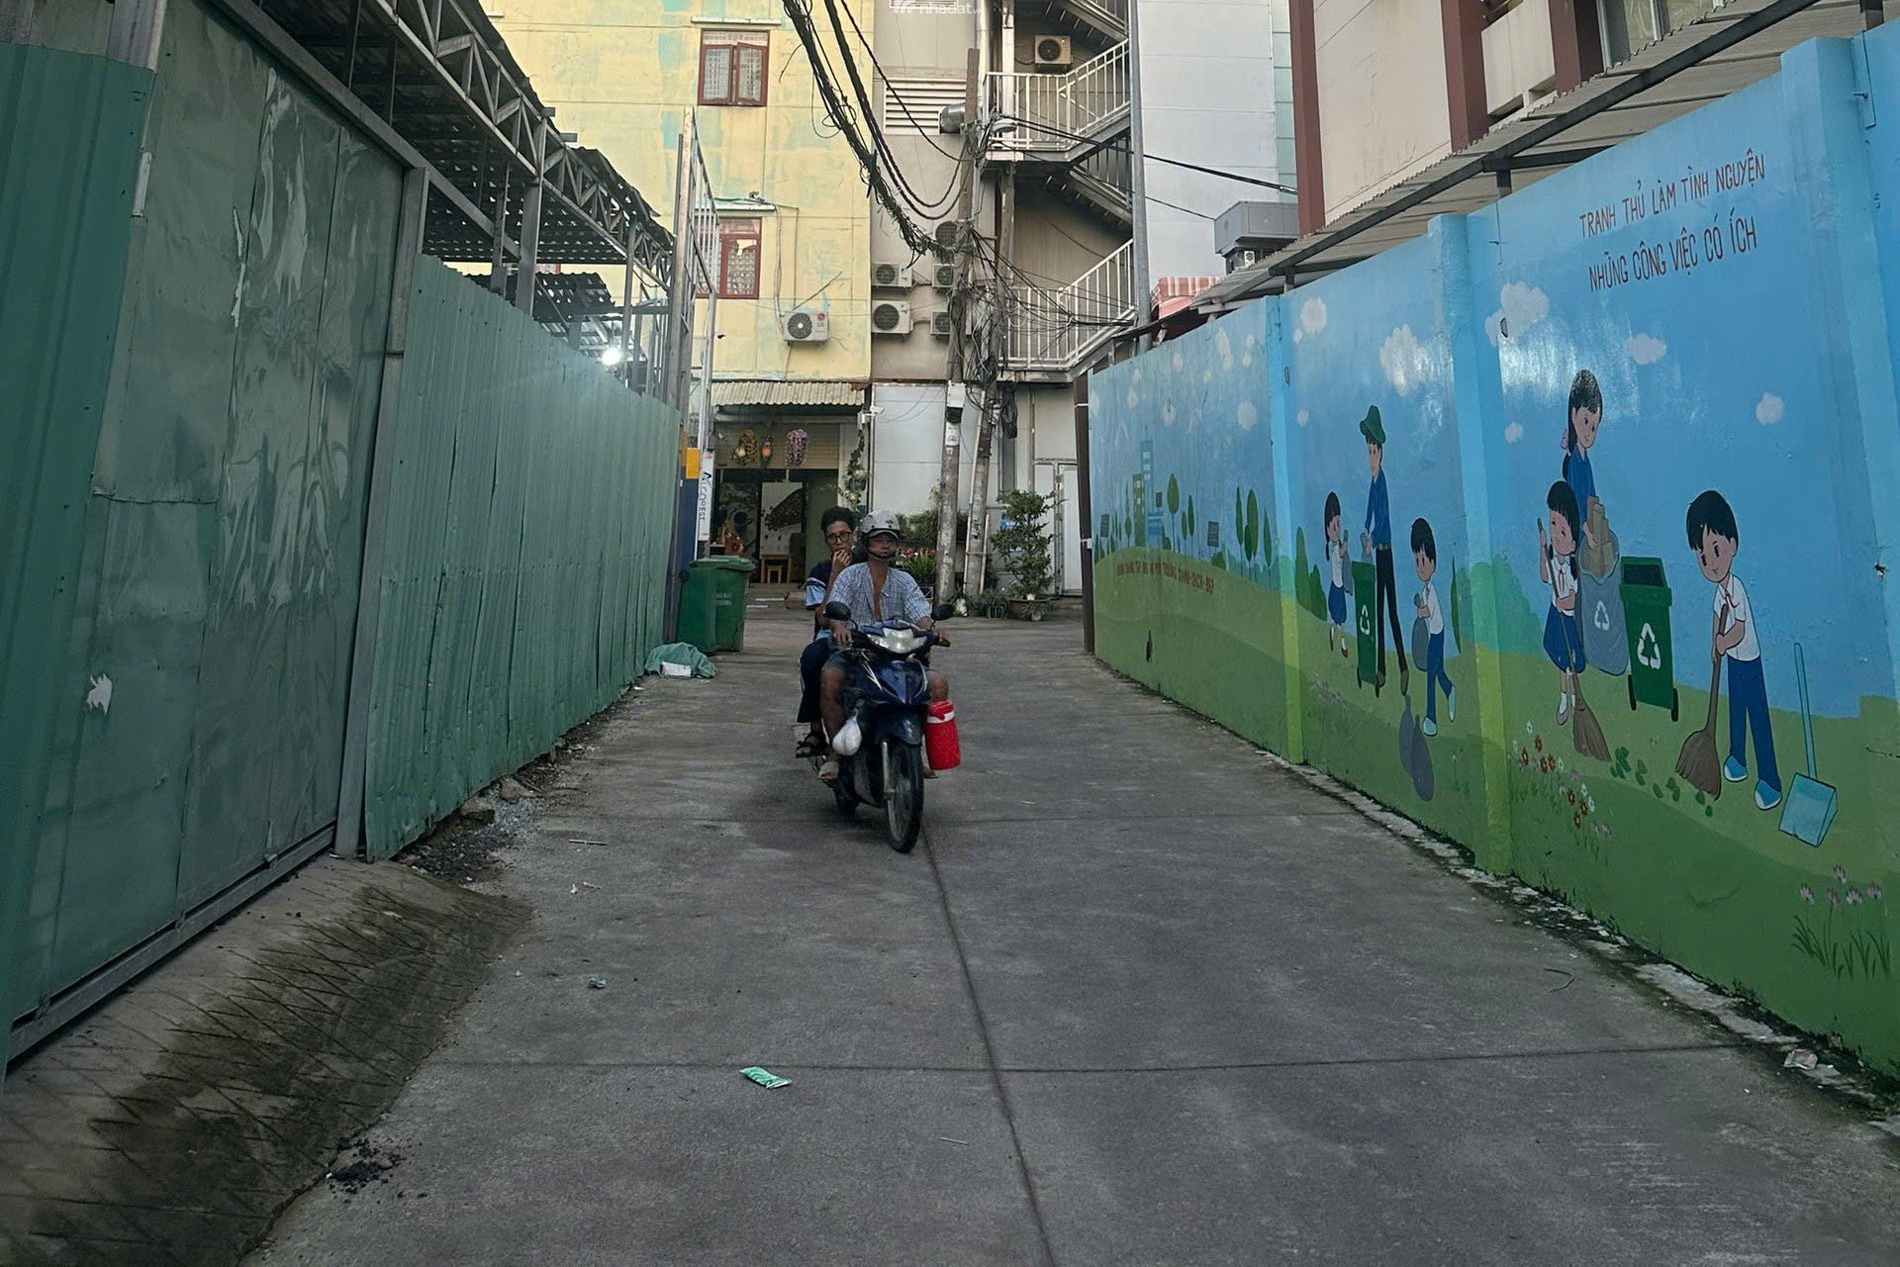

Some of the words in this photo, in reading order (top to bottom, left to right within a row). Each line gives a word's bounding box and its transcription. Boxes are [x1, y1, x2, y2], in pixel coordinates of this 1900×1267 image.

[1580, 204, 1616, 238] TRANH
[1622, 180, 1645, 223] THỦ
[1652, 179, 1676, 215] LÀM
[1681, 165, 1709, 203] TÌNH
[1715, 147, 1765, 193] NGUYỆN
[1632, 240, 1666, 281] CÔNG
[1669, 226, 1698, 275] VIỆC
[1704, 213, 1723, 263] CÓ
[1729, 207, 1757, 254] ÍCH
